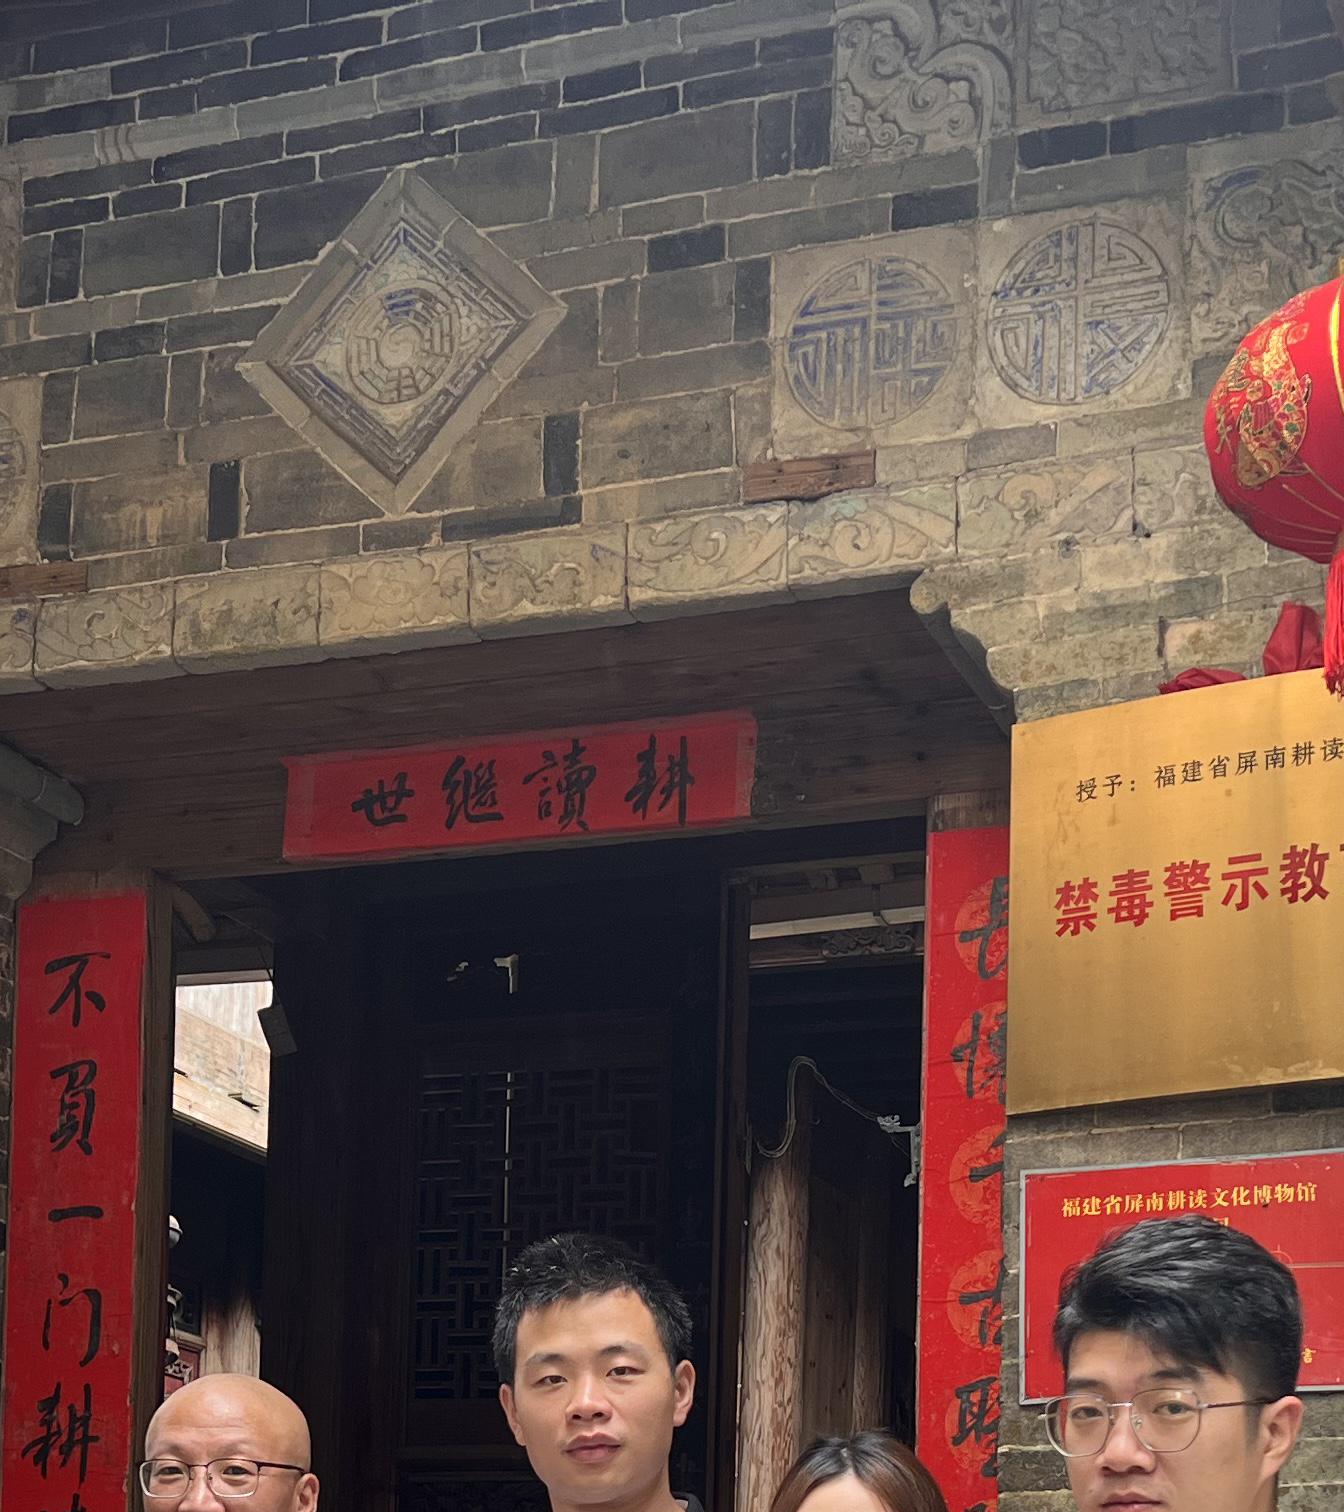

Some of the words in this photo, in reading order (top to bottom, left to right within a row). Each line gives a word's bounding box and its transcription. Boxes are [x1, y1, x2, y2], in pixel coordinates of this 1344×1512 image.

[1061, 1181, 1318, 1218] 福建省屏南耕读文化博物馆
